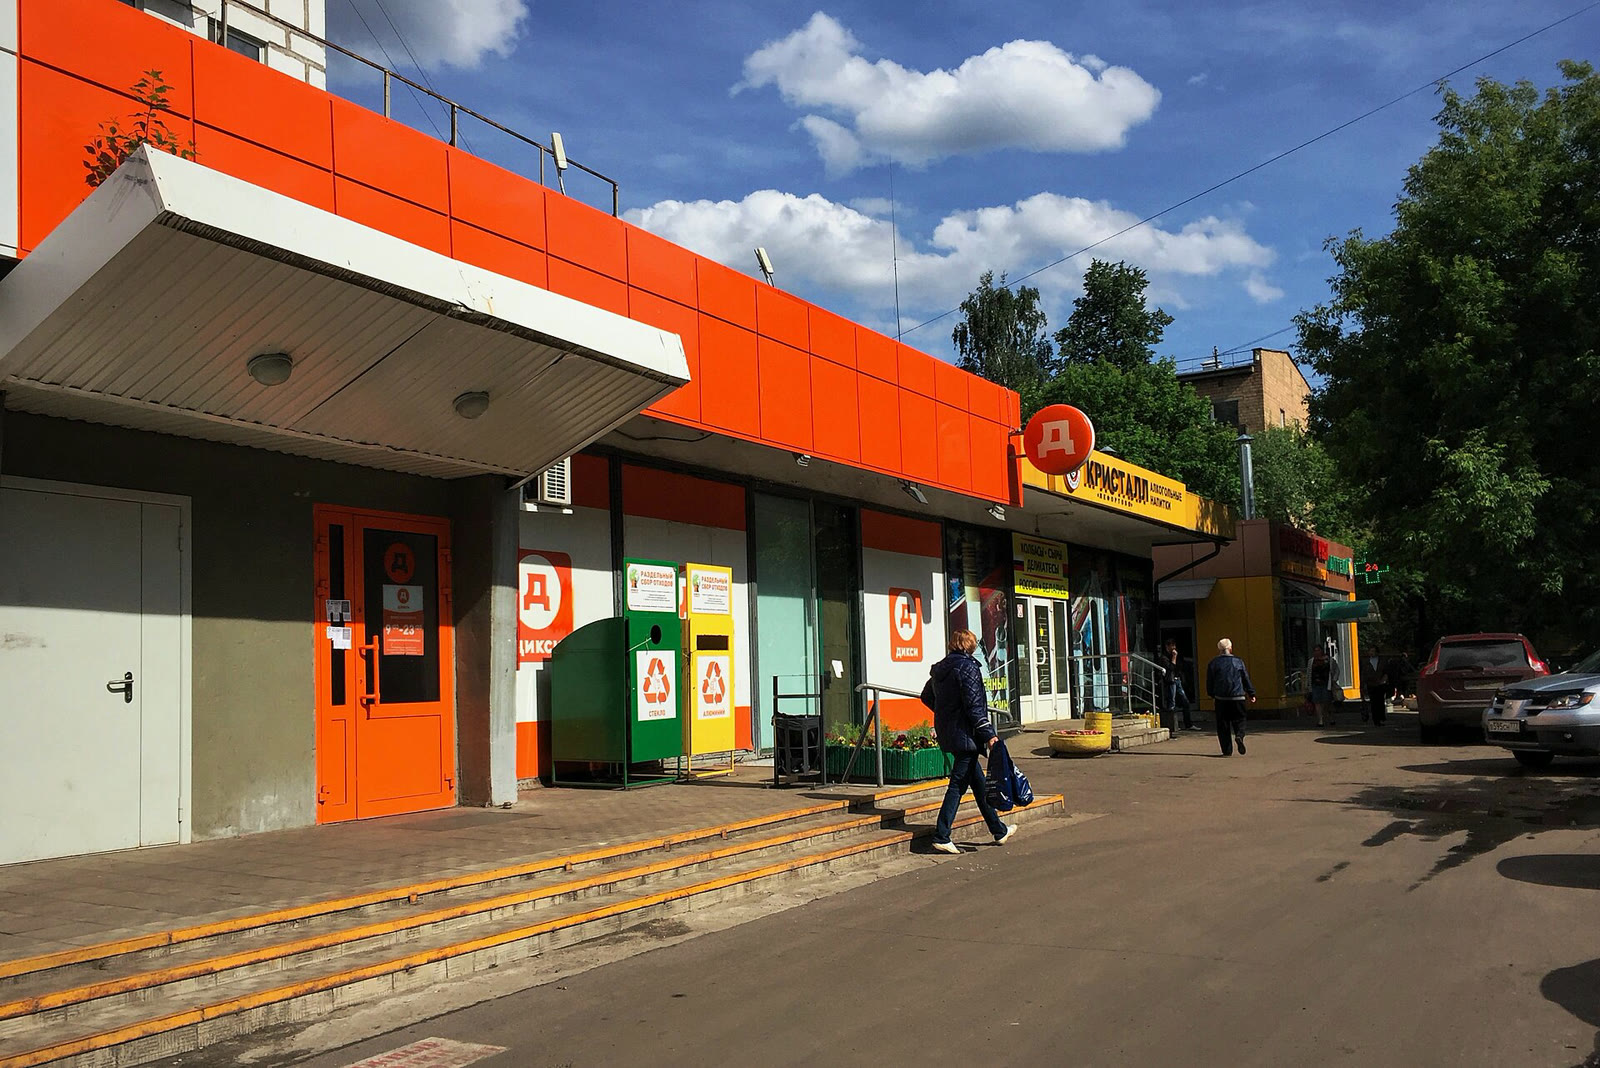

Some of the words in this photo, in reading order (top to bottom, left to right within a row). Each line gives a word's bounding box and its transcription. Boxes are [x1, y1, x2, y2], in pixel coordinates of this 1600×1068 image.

[1038, 420, 1076, 459] Д
[1085, 460, 1149, 503] КРИСТАЛЛ
[1150, 482, 1182, 502] АЛКОГОЛЬНЫЕ
[1150, 495, 1172, 511] НАПИТКИ
[640, 570, 673, 579] РАЗДЕЛЬНЫЙ
[523, 573, 550, 611] Д
[900, 603, 912, 628] Д
[895, 646, 919, 659] ДИКСИ
[649, 709, 666, 717] СТЕКЛО
